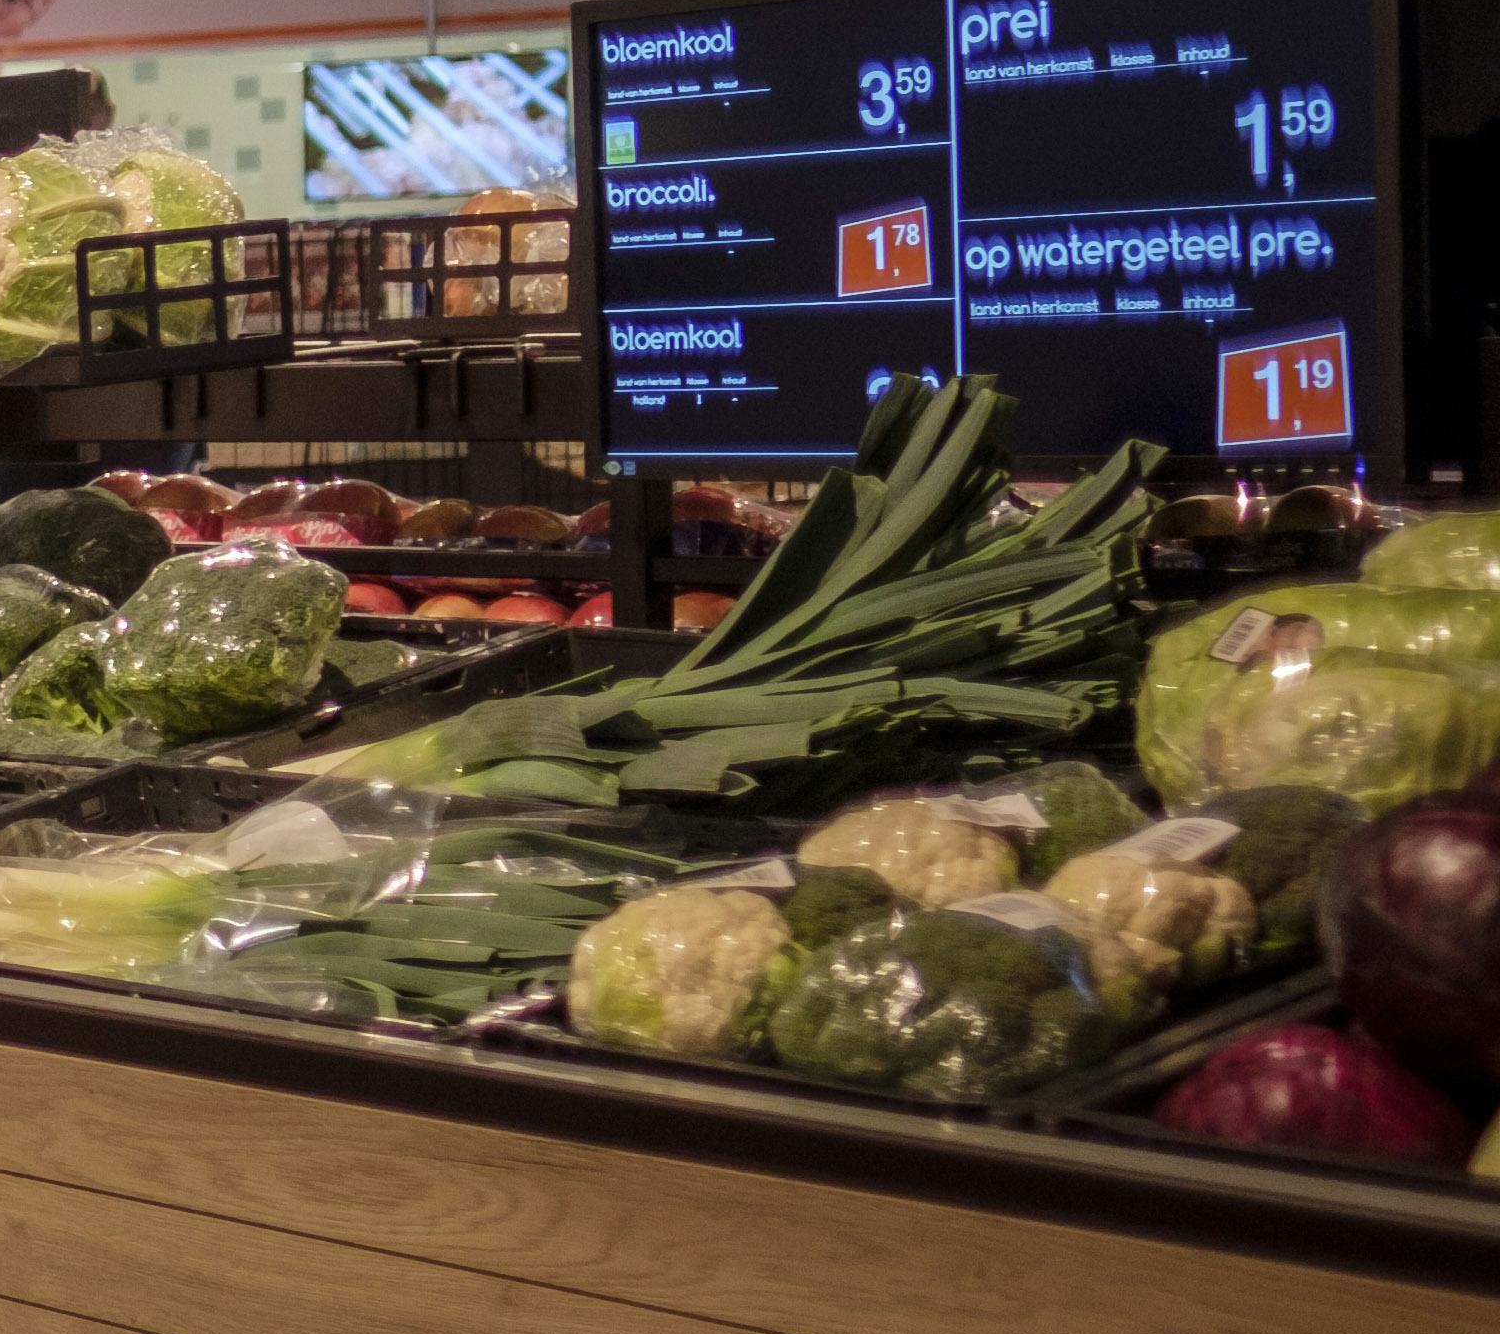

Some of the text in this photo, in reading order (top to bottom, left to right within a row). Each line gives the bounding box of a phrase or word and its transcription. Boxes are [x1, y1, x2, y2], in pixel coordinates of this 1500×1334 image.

[603, 25, 734, 63] bloemkool
[961, 1, 1049, 55] prei
[965, 44, 1230, 80] land van herkomst klasse inhoud
[859, 66, 933, 134] 3,59
[1234, 98, 1333, 187] 1,59
[607, 176, 715, 207] broccoli.
[866, 223, 920, 277] 1,78
[966, 245, 1009, 278] op
[1018, 225, 1240, 271] watergeteel
[970, 294, 1235, 317] land van herkomst klasse inhoud
[611, 321, 742, 351] bloemkool
[1253, 358, 1335, 431] 1,19
